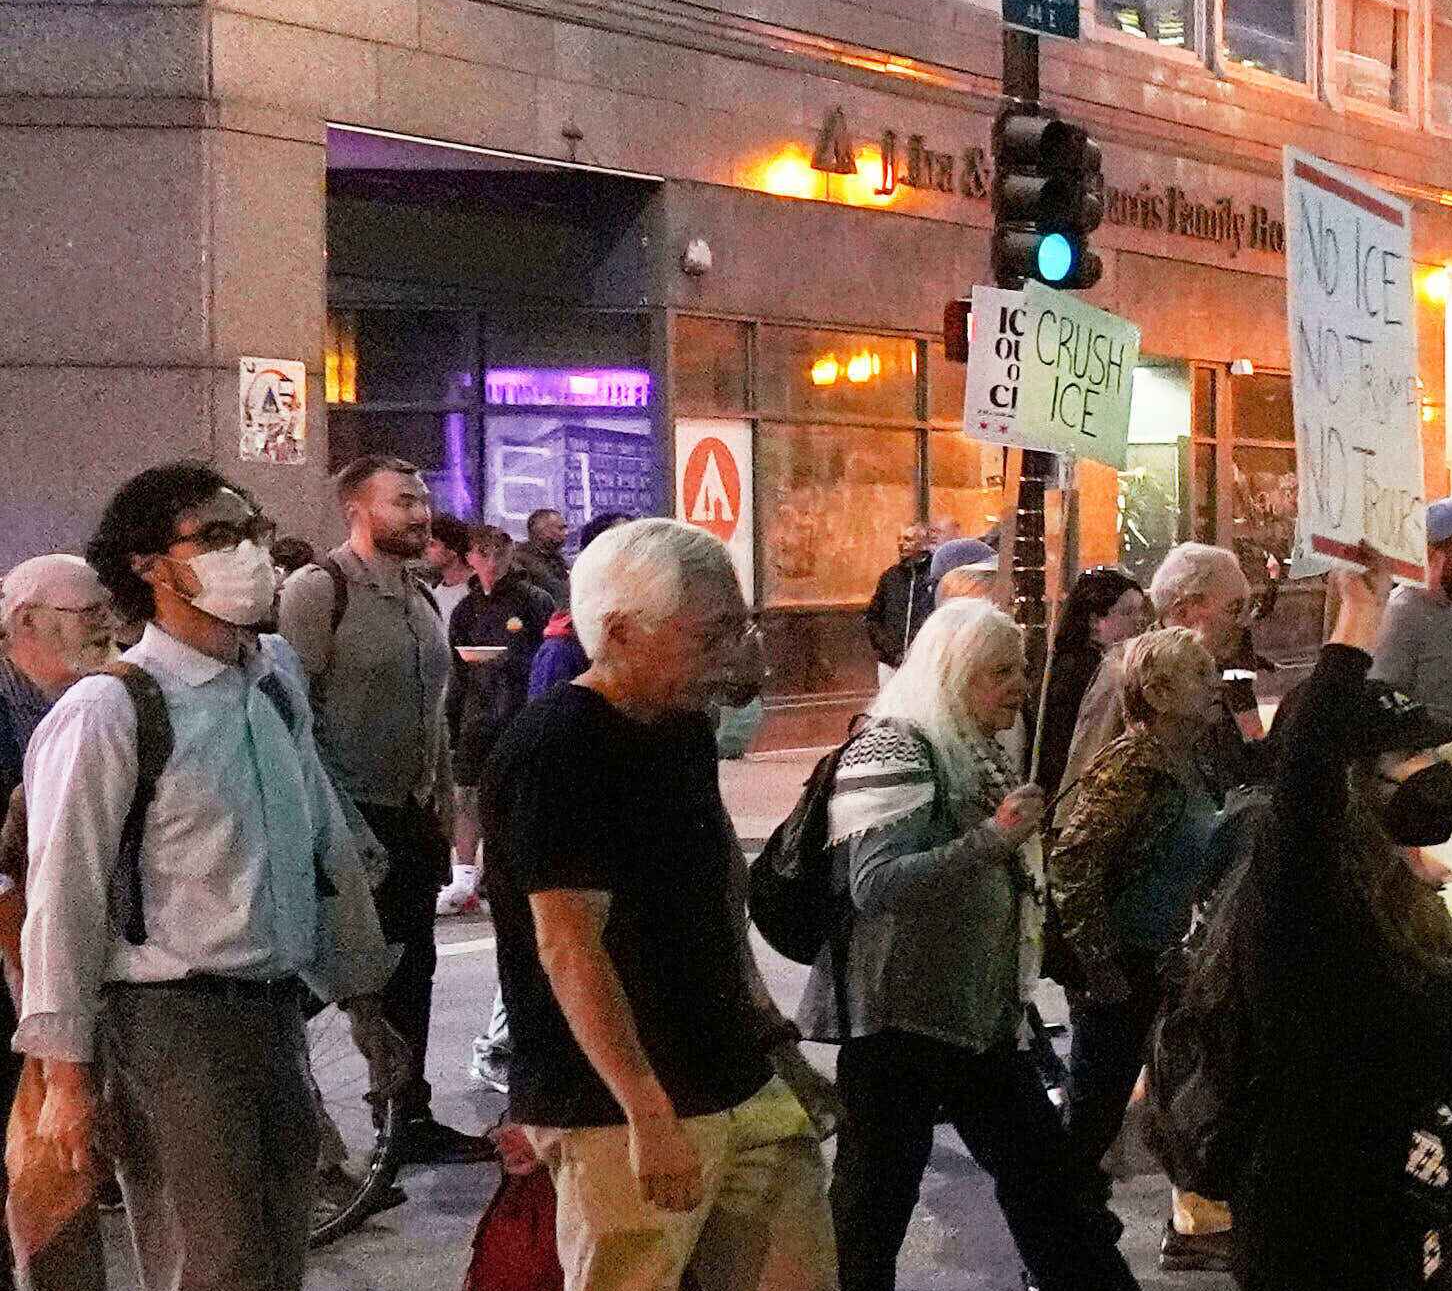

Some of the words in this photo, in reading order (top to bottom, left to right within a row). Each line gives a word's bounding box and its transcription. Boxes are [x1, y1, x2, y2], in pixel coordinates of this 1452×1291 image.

[1354, 217, 1402, 326] ICE
[999, 306, 1027, 337] IC
[1036, 309, 1125, 394] CRUSH
[1051, 375, 1101, 439] ICE
